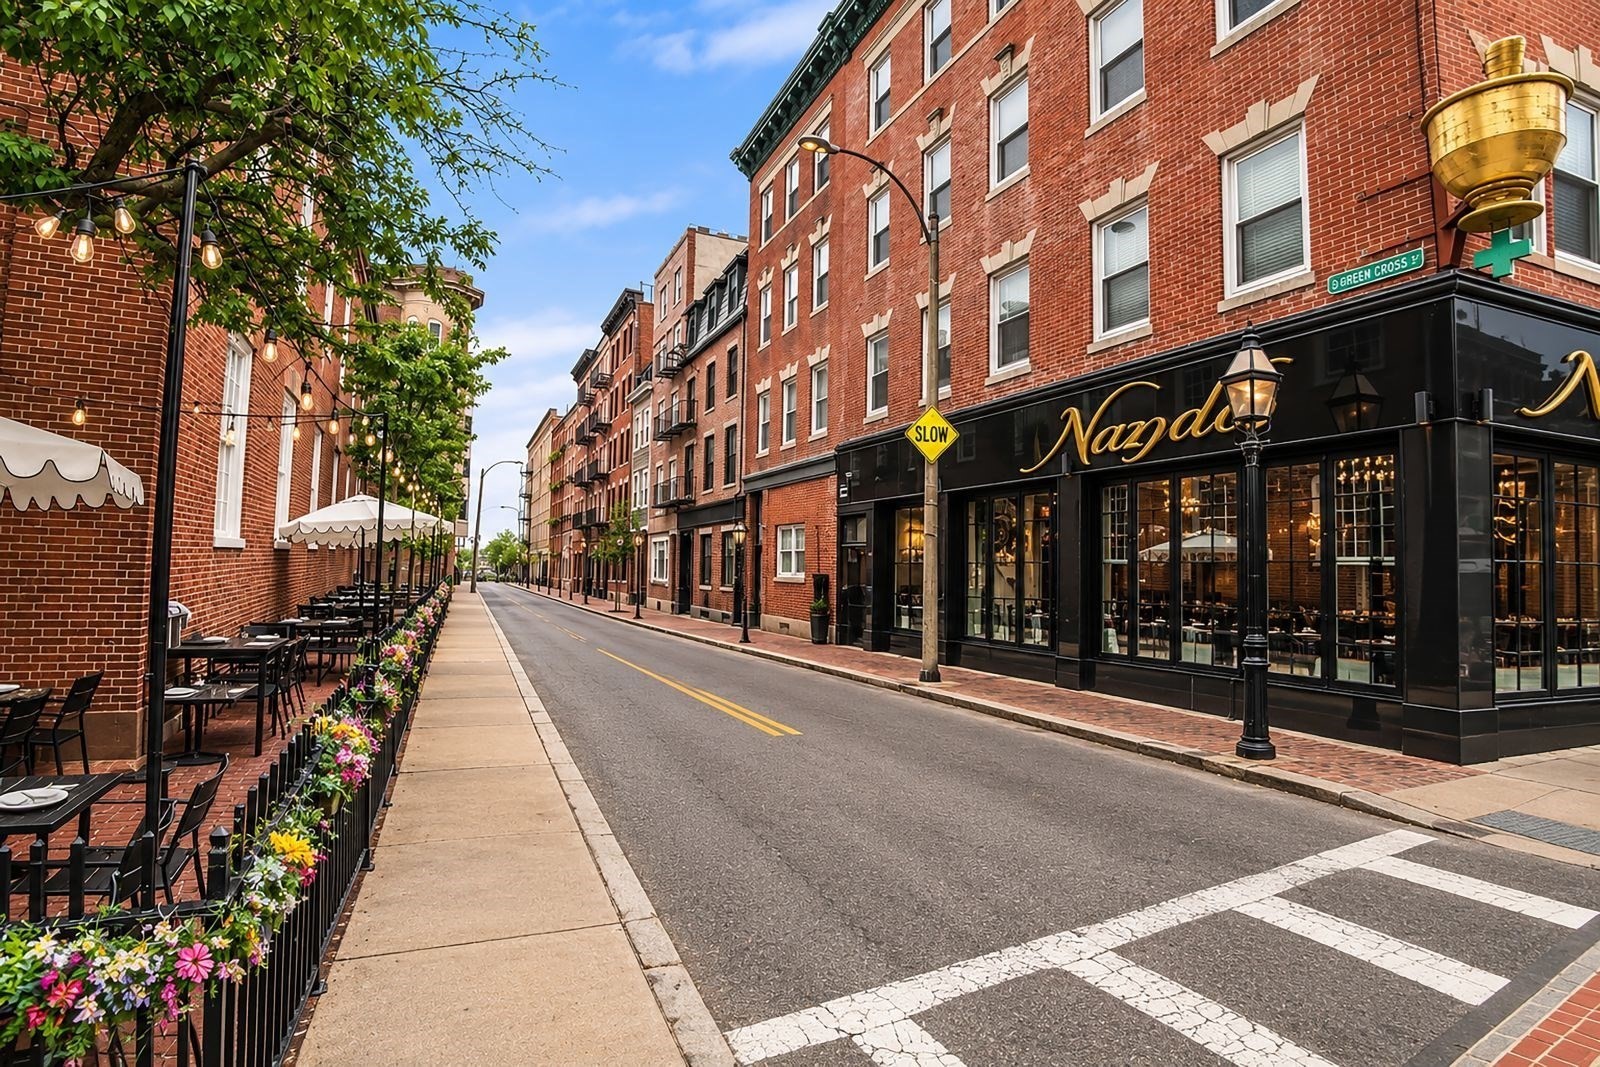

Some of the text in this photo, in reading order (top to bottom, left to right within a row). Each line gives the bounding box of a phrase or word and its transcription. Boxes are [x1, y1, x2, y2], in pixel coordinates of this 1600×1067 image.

[1340, 268, 1371, 287] GREEN
[1374, 257, 1408, 277] CROSS
[915, 425, 949, 443] SLOW
